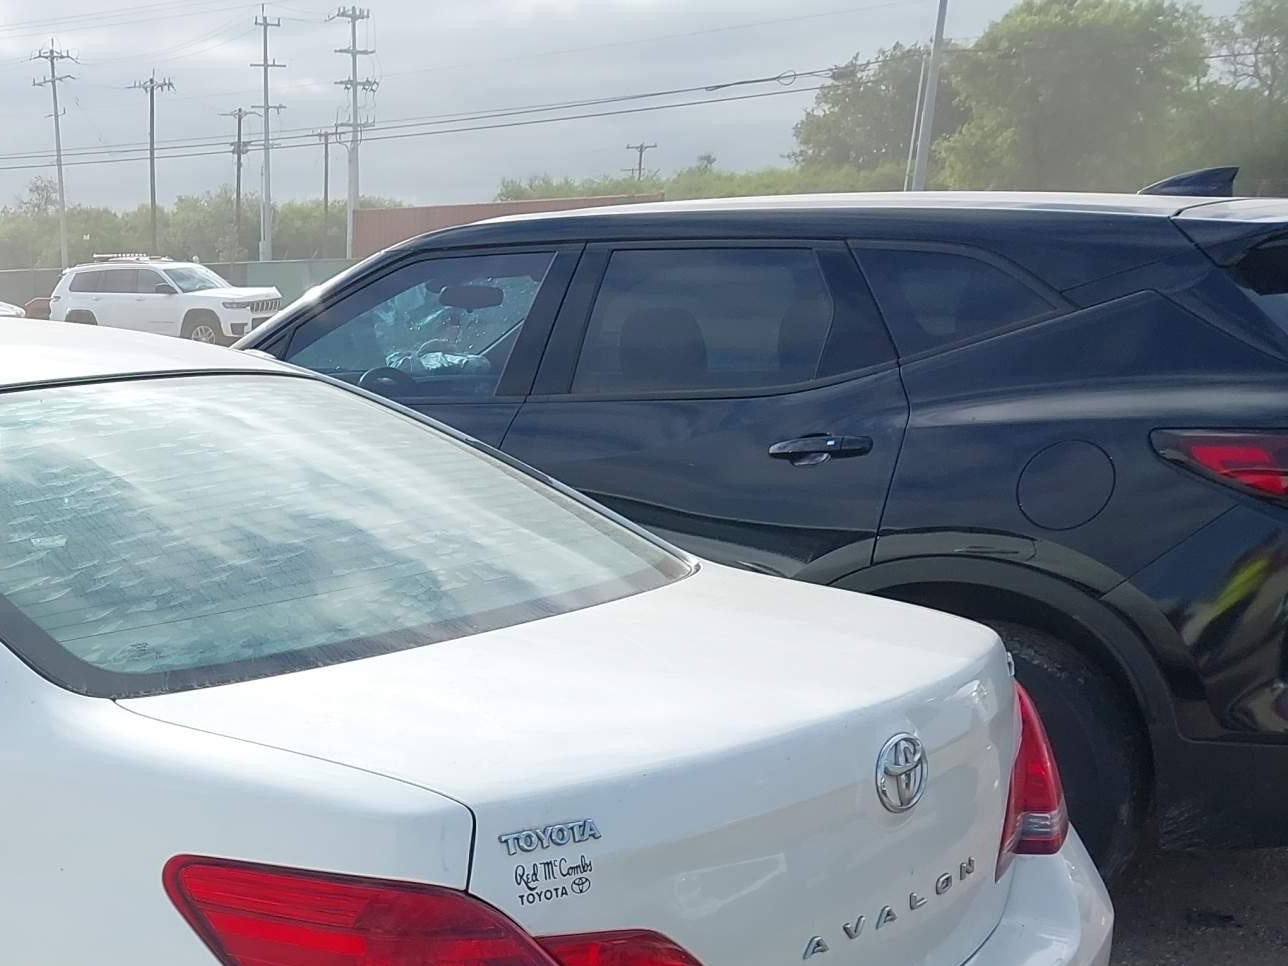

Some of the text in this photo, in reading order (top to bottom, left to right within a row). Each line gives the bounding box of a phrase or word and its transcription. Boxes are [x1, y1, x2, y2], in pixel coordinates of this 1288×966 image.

[498, 818, 602, 856] TOYOTA
[515, 863, 540, 892] Red
[518, 886, 569, 906] TOYOTA
[802, 856, 976, 960] AVALON
